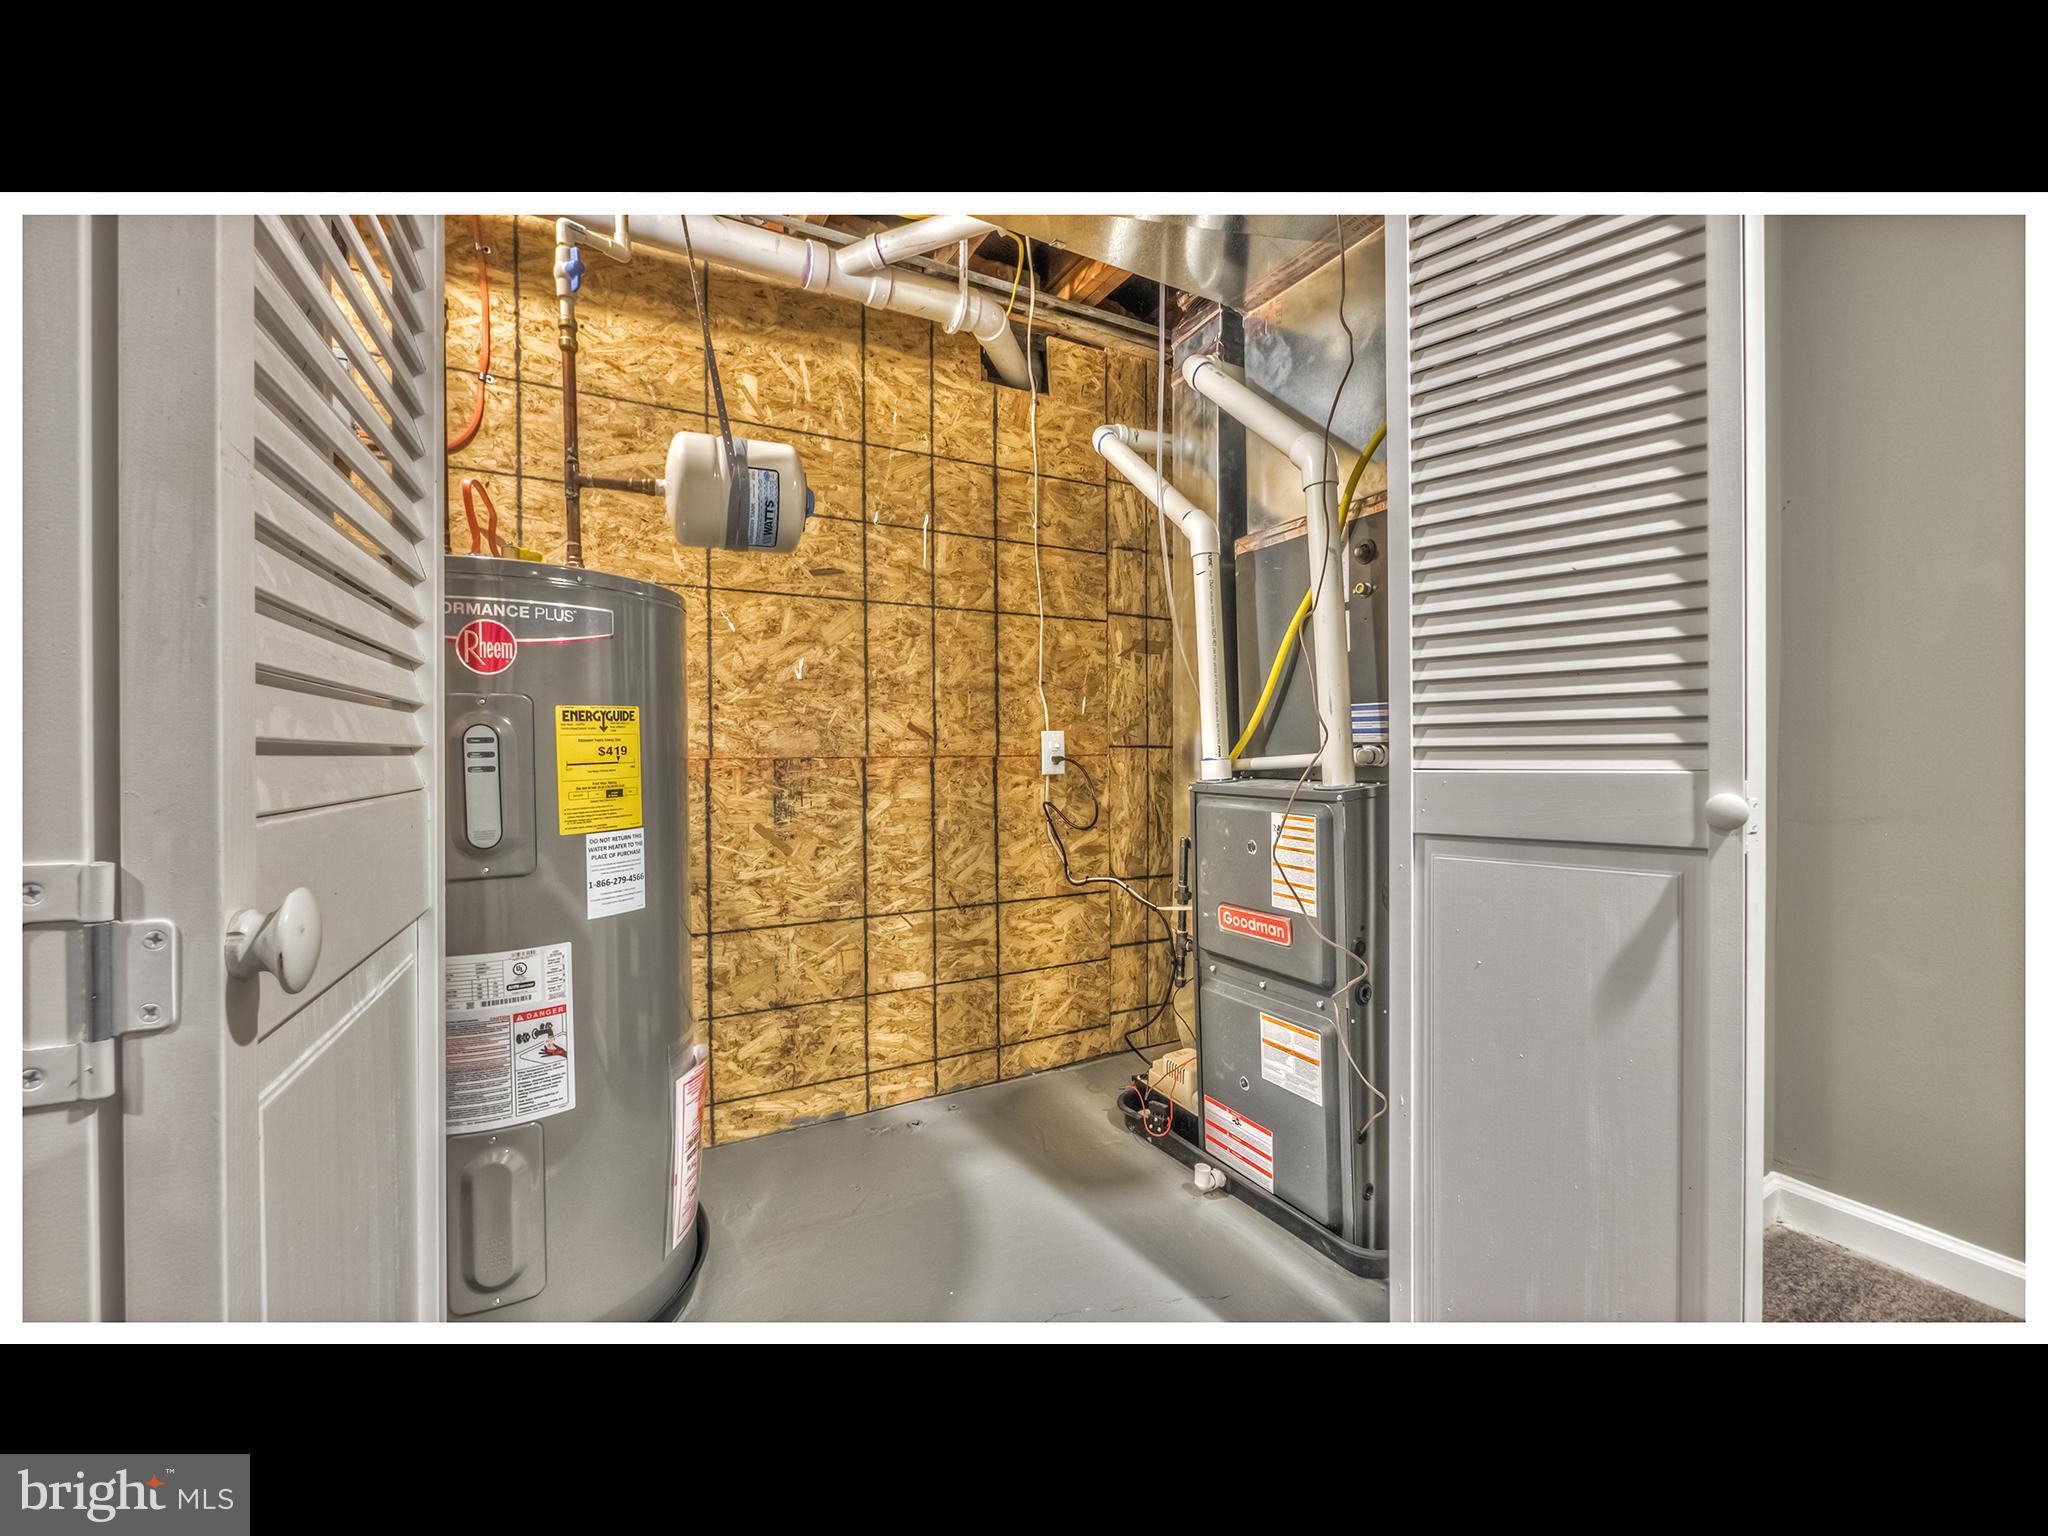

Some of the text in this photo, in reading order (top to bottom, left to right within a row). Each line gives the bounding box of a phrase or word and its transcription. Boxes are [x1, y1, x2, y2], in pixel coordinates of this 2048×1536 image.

[763, 500, 775, 537] WATTS
[535, 607, 575, 622] PLUS
[464, 621, 513, 666] Rheem
[561, 710, 635, 724] ENERGYGUIDE
[597, 745, 628, 757] $419
[612, 834, 632, 842] RETURN
[588, 845, 607, 853] WATER
[608, 843, 627, 851] HEATER
[617, 848, 641, 857] PURCHASE
[589, 873, 645, 889] 1-866-279-4566
[1222, 911, 1285, 938] Goodman
[526, 1006, 564, 1020] DANGER
